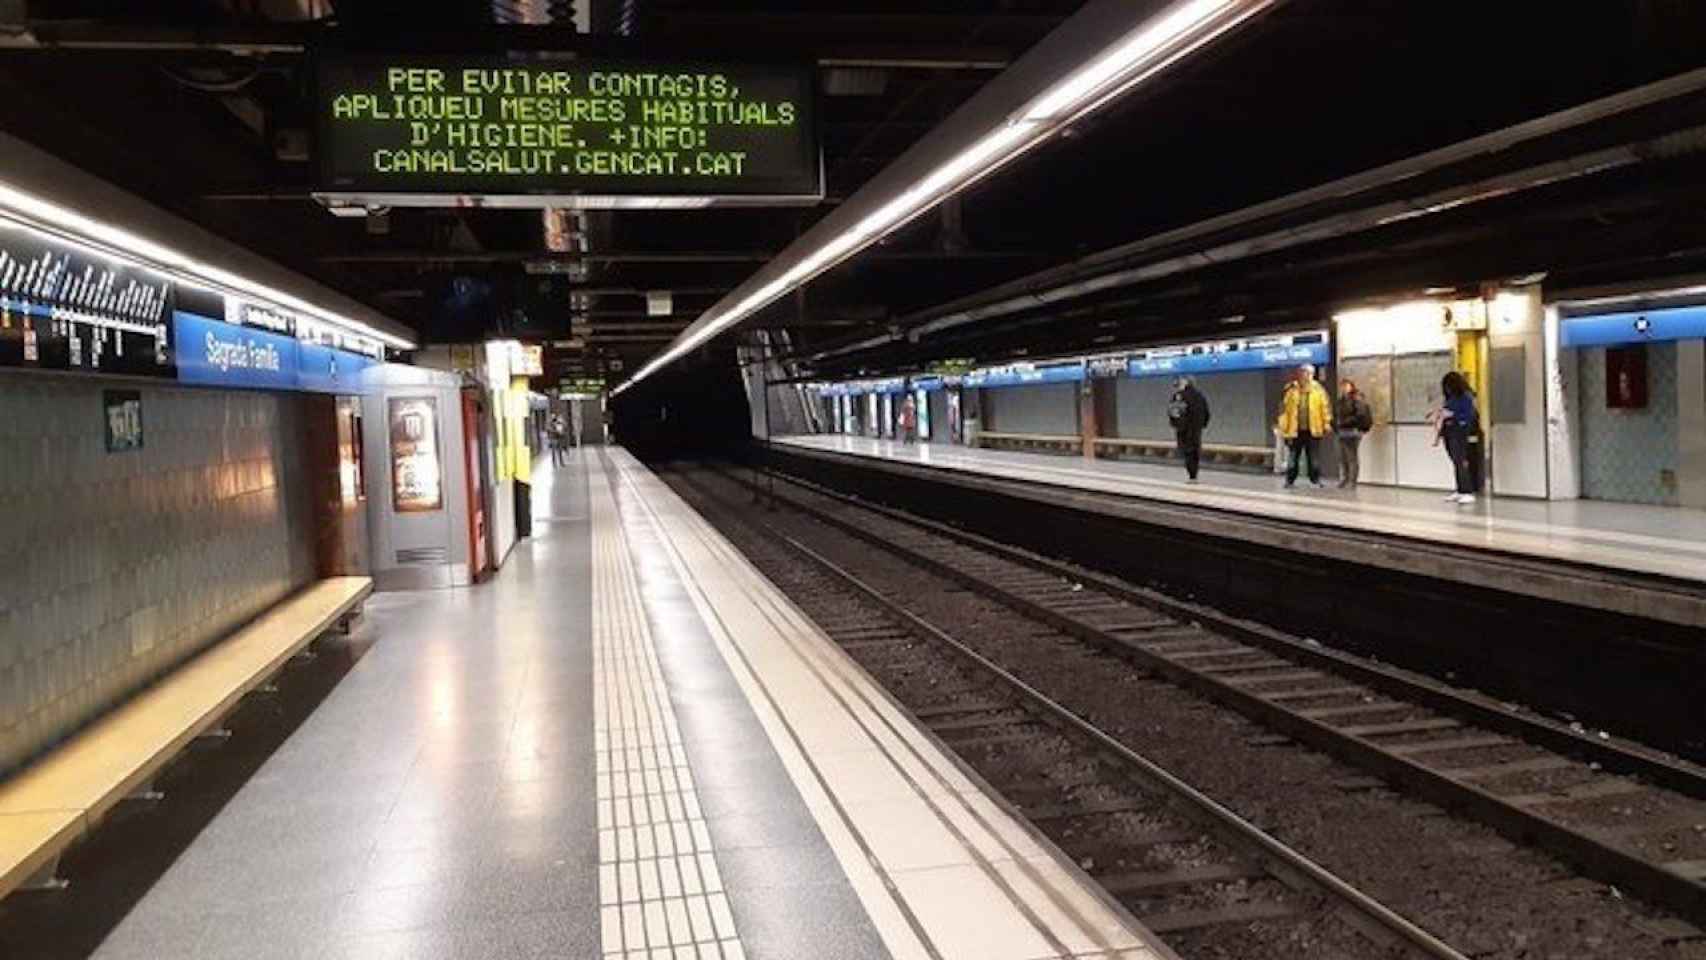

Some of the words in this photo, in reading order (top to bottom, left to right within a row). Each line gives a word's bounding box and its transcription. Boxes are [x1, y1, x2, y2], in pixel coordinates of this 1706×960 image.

[387, 67, 446, 92] PER
[588, 72, 740, 99] CONTAGIS,
[332, 94, 483, 119] APLIQUEU
[500, 96, 626, 122] MESURES
[642, 100, 795, 125] HABITUALS
[409, 121, 587, 148] D'HIGIENE.
[609, 125, 707, 149] +INFO:
[373, 149, 746, 176] CANALSALUT.GENCAT.CAT
